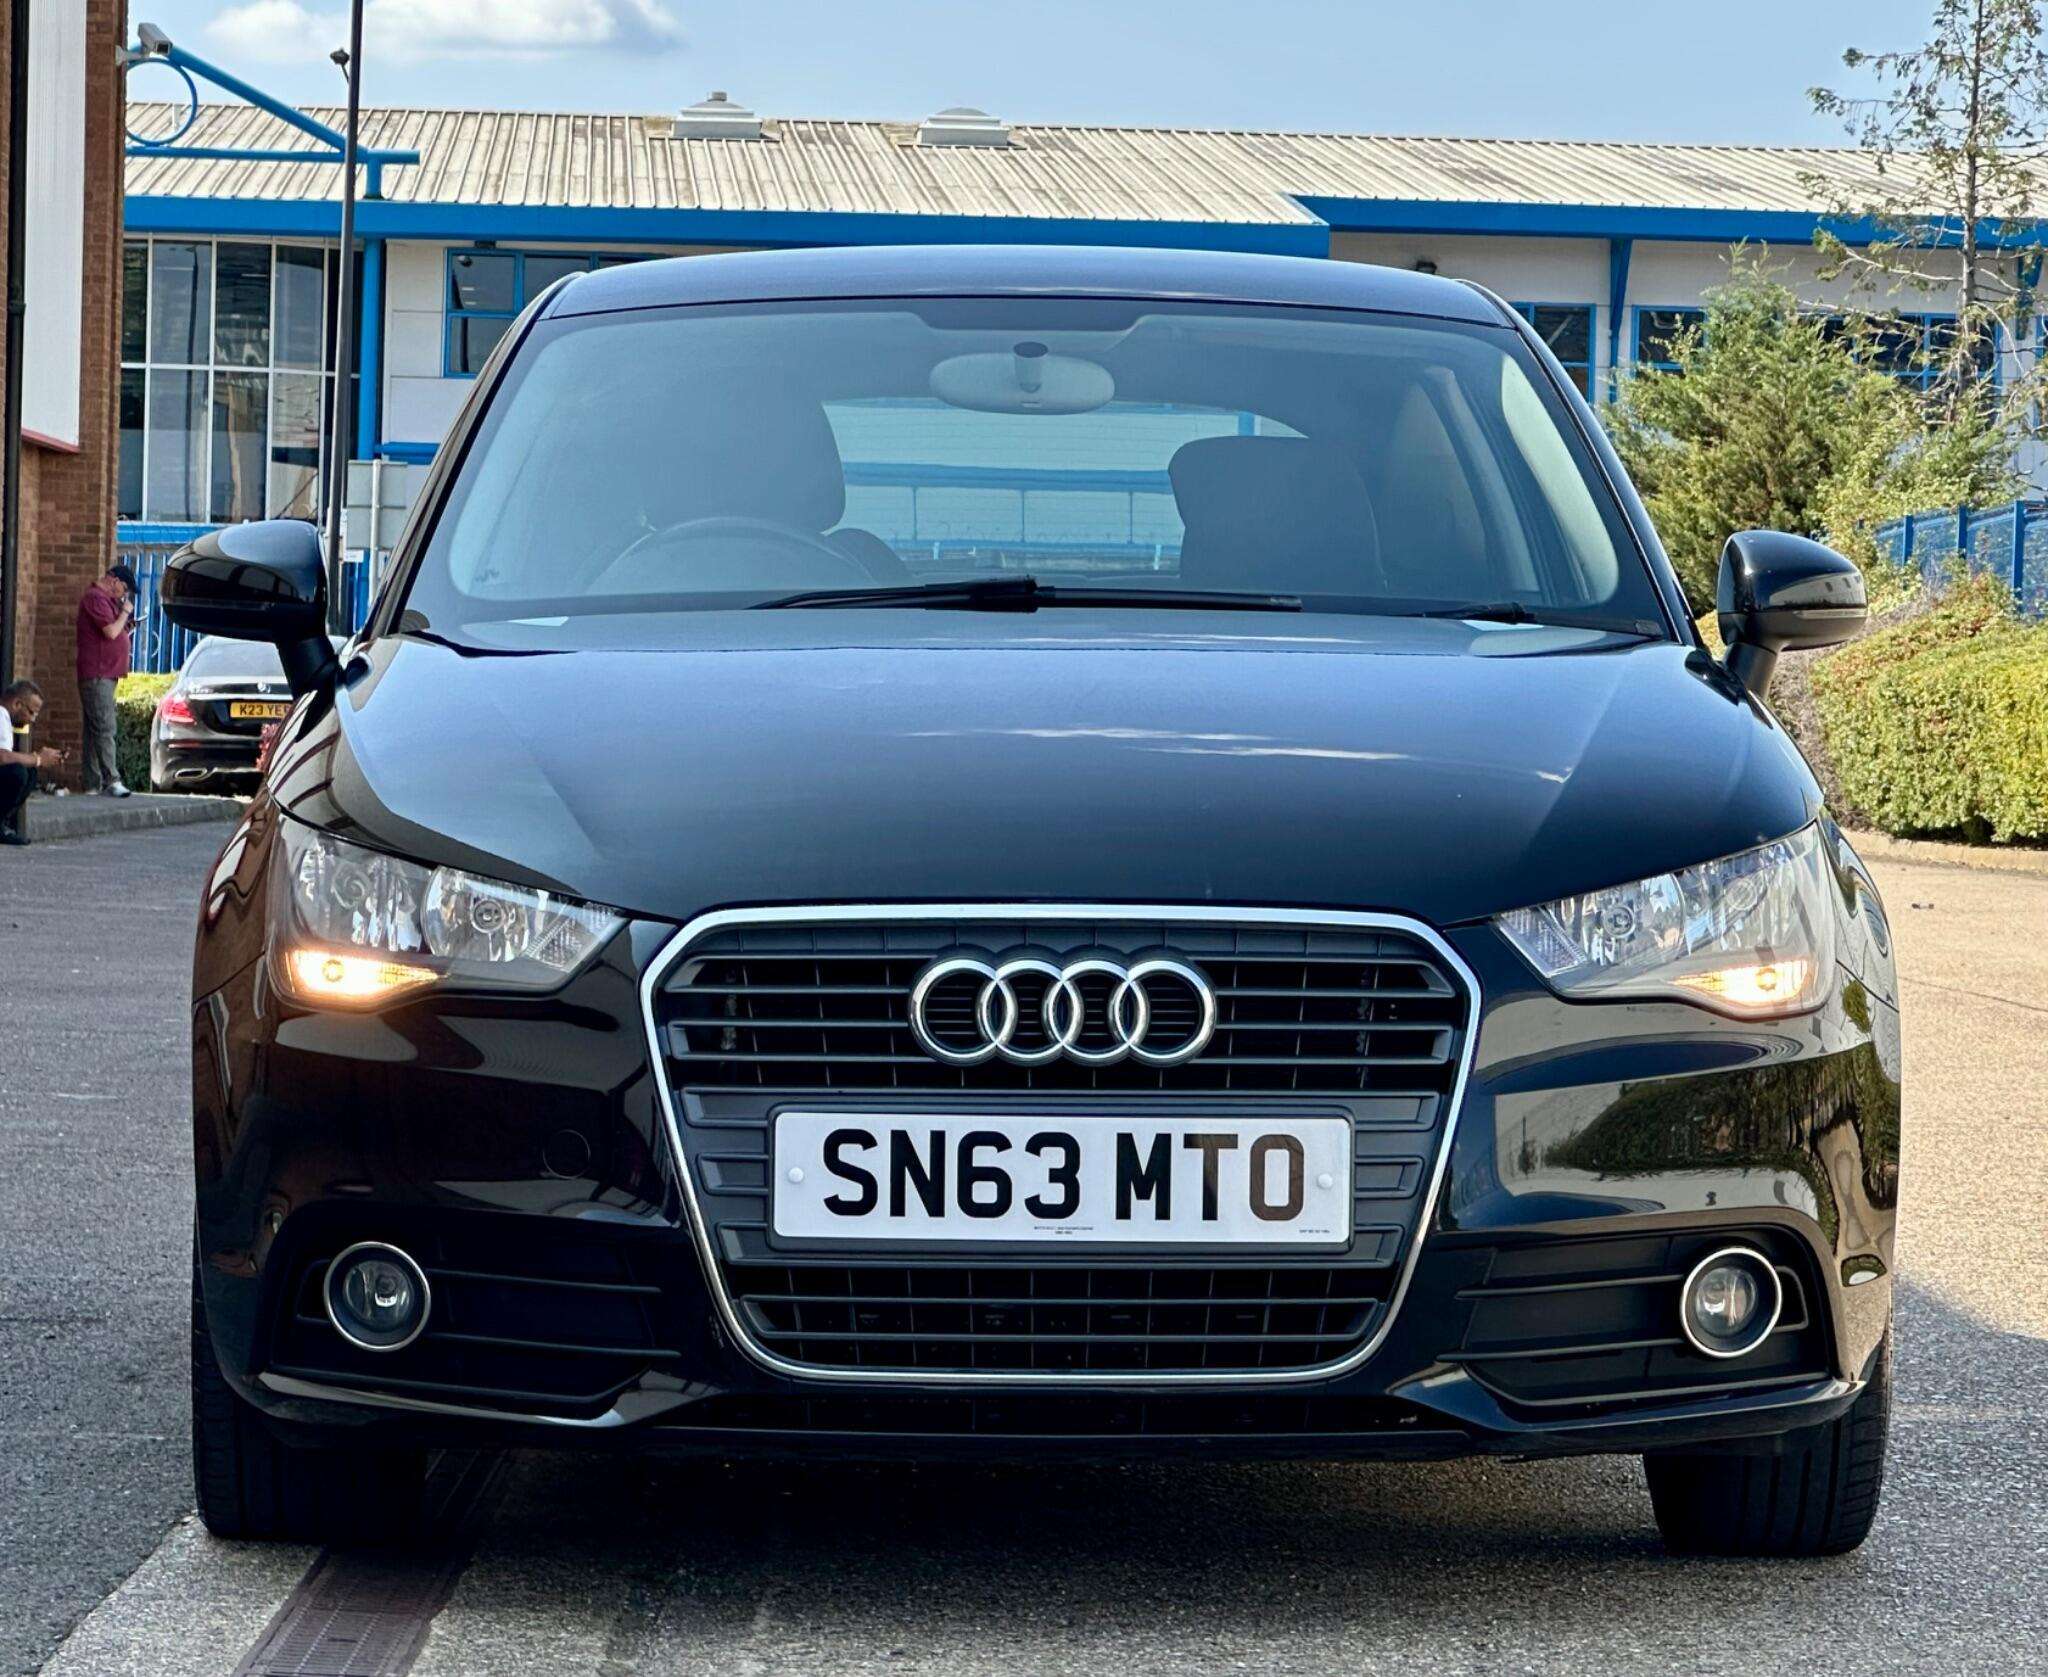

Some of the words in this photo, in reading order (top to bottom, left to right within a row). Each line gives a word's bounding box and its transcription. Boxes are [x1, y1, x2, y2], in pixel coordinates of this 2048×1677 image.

[239, 704, 264, 716] K23
[823, 1128, 1081, 1219] SN63
[1115, 1132, 1305, 1221] MTO
